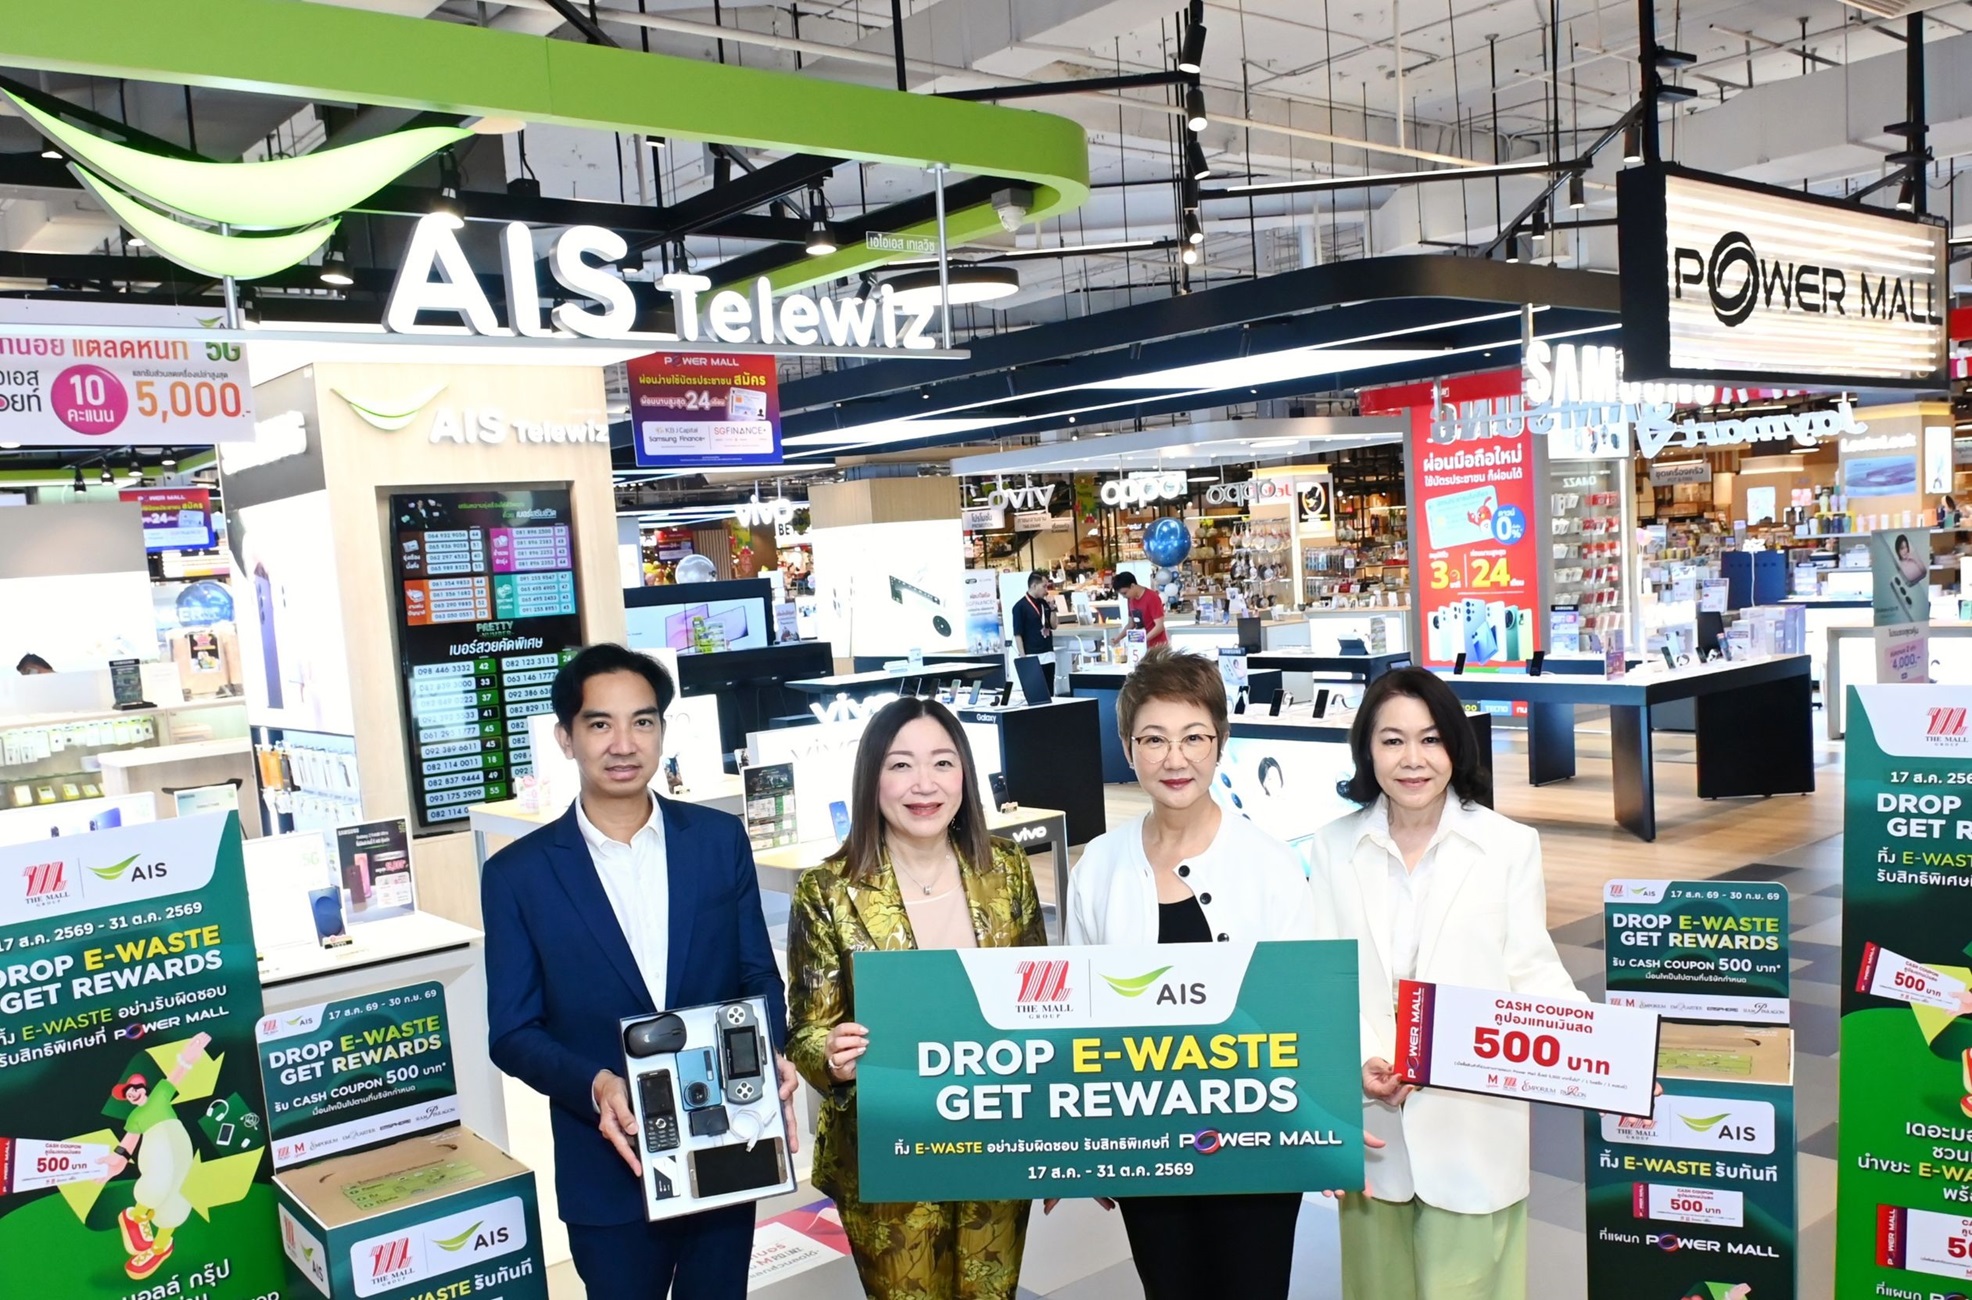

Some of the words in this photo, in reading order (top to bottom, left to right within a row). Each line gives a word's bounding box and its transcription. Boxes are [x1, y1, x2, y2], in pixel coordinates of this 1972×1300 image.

[386, 213, 636, 339] AIS
[656, 273, 936, 349] Telewiz
[1675, 231, 1845, 327] POWER
[1861, 272, 1942, 325] MALL
[711, 358, 739, 366] MALL
[69, 374, 105, 406] 10
[734, 372, 766, 385] สมัคร
[686, 390, 711, 410] 24
[67, 409, 114, 423] คะแนน
[429, 407, 506, 443] AIS
[511, 419, 610, 443] Telewiz
[1423, 443, 1522, 472] ผ่อนมือถือใหม่
[1101, 476, 1180, 509] oppo
[735, 494, 793, 527] vivo
[1430, 560, 1449, 590] 3
[1471, 558, 1510, 588] 24
[476, 621, 513, 632] PRETTY
[449, 636, 543, 656] เบอร์สวยคัดพิเศษ
[976, 712, 997, 723] Galaxy
[463, 790, 481, 798] 3999
[1877, 793, 1962, 815] DROP
[1013, 825, 1047, 842] vivo
[1887, 817, 1946, 839] GET
[131, 862, 167, 882] AIS
[1707, 891, 1719, 899] 69
[1730, 892, 1742, 900] 30
[19, 933, 50, 948] ส.ค.
[54, 922, 94, 941] 2569
[109, 916, 128, 929] 31
[165, 902, 203, 919] 2569
[1613, 913, 1672, 928] DROP
[1679, 915, 1779, 932] E-WASTE
[1620, 932, 1661, 946] GET
[1669, 932, 1779, 951] REWARDS
[1613, 957, 1625, 967] รับ
[1629, 959, 1660, 968] CASH
[1664, 960, 1714, 971] COUPON
[1718, 958, 1752, 972] 500
[1, 984, 61, 1014] GET
[72, 950, 223, 1000] REWARDS
[329, 1011, 340, 1020] 17
[366, 1003, 378, 1012] 69
[389, 997, 400, 1006] 30
[425, 989, 437, 999] 69
[1156, 983, 1207, 1006] AIS
[1015, 1004, 1038, 1013] THE
[1042, 1003, 1074, 1012] MALL
[1495, 999, 1532, 1012] CASH
[1536, 1004, 1594, 1020] COUPON
[114, 1017, 180, 1040] POWER
[186, 1005, 229, 1024] MALL
[300, 1018, 313, 1026] AIS
[1495, 1012, 1593, 1034] คูปองแทนเงินสด
[269, 1040, 334, 1069] DROP
[340, 1015, 440, 1052] E-WASTE
[1474, 1026, 1561, 1067] 500
[1567, 1057, 1610, 1075] บาท
[280, 1062, 324, 1085] GET
[332, 1035, 442, 1074] REWARDS
[917, 1039, 1055, 1077] DROP
[1072, 1032, 1299, 1073] E-WASTE
[274, 1101, 289, 1113] รับ
[293, 1091, 327, 1107] CASH
[330, 1078, 383, 1097] COUPON
[386, 1065, 419, 1084] 500
[936, 1084, 1030, 1121] GET
[1049, 1077, 1299, 1119] REWARDS
[895, 1139, 909, 1155] ทิ้ง
[915, 1142, 983, 1155] E-WASTE
[987, 1139, 1079, 1154] อย่างรับผิดชอบ
[1084, 1132, 1169, 1151] รับสิทธิพิเศษที่
[1179, 1127, 1271, 1154] POWER
[1280, 1130, 1342, 1145] MALL
[1617, 1128, 1639, 1136] THE
[1719, 1125, 1756, 1142] AIS
[1028, 1166, 1047, 1180] 17
[1051, 1166, 1081, 1178] ส.ค.
[1097, 1165, 1116, 1177] 31
[1155, 1163, 1194, 1176] 2569
[1600, 1149, 1619, 1168] ทิ้ง
[1624, 1156, 1711, 1177] E-WASTE
[1716, 1162, 1777, 1182] รับทันที
[1670, 1198, 1703, 1212] 500
[474, 1227, 509, 1251] AIS
[1600, 1228, 1640, 1244] ที่แผนก
[1646, 1232, 1721, 1253] POWER
[1727, 1243, 1780, 1258] MALL
[190, 1258, 229, 1287] กรุ๊ป
[371, 1276, 389, 1285] THE
[391, 1268, 415, 1279] MALL
[474, 1258, 533, 1291] รับทันที
